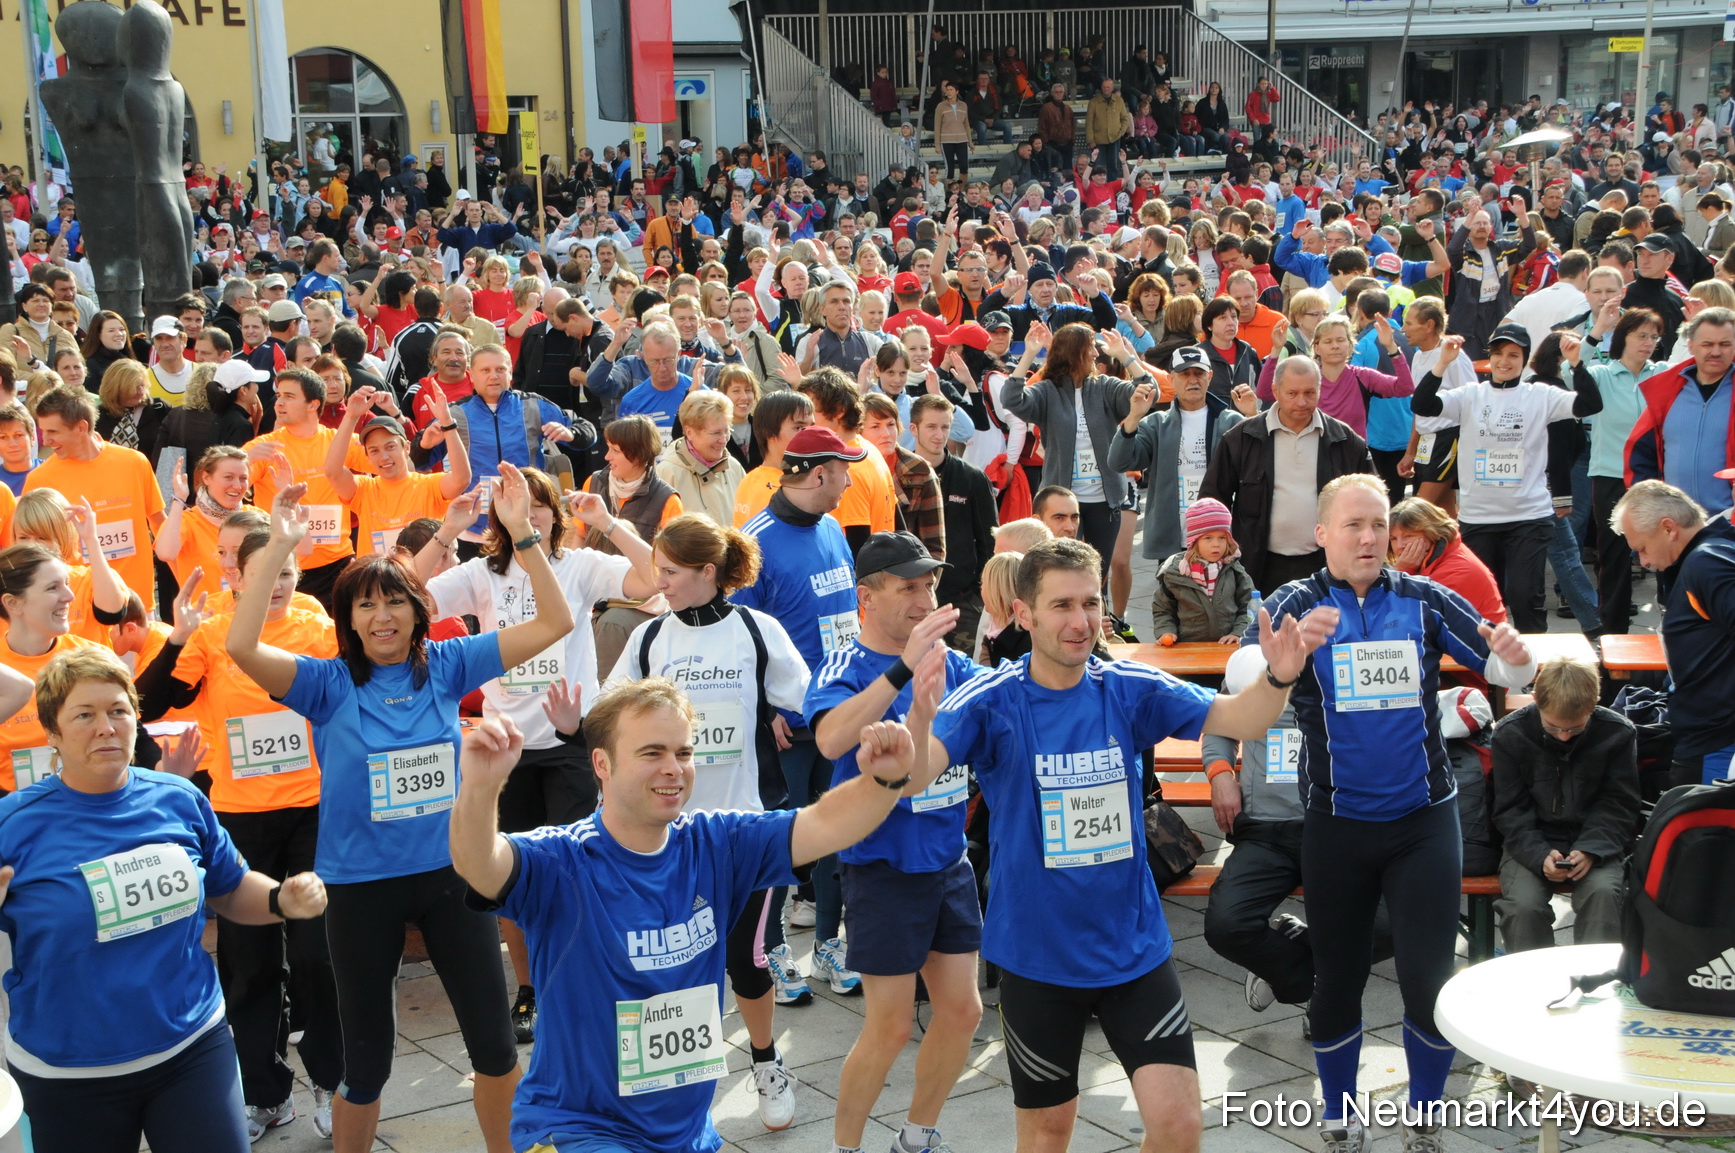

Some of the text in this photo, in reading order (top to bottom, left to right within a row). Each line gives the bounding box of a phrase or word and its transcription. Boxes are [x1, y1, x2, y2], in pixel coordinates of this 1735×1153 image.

[1321, 54, 1365, 69] Rupprecht
[543, 110, 559, 121] 24
[1489, 452, 1519, 460] Alexandra
[1488, 463, 1518, 473] 3401
[1186, 479, 1199, 487] Toni
[308, 519, 336, 530] 3515
[97, 531, 129, 546] 2315
[1356, 648, 1404, 661] Christian
[516, 659, 559, 676] 5158
[674, 665, 743, 682] Fischer
[1359, 666, 1411, 686] 3404
[684, 681, 743, 691] Automobile
[252, 733, 302, 756] 5219
[393, 752, 439, 770] Elisabeth
[1035, 746, 1125, 776] HUBER
[396, 770, 446, 795] 3399
[1056, 769, 1124, 786] TECHNOLOGY
[1070, 795, 1106, 811] Walter
[1073, 812, 1122, 839] 2541
[113, 854, 162, 877] Andrea
[124, 869, 190, 907] 5163
[96, 890, 105, 904] S
[626, 905, 716, 957] HUBER
[650, 932, 717, 967] TECHNOLOGY
[644, 1002, 683, 1024] Andre
[622, 1038, 629, 1052] S
[648, 1024, 713, 1060] 5083
[686, 1063, 726, 1079] PFLEIDERER
